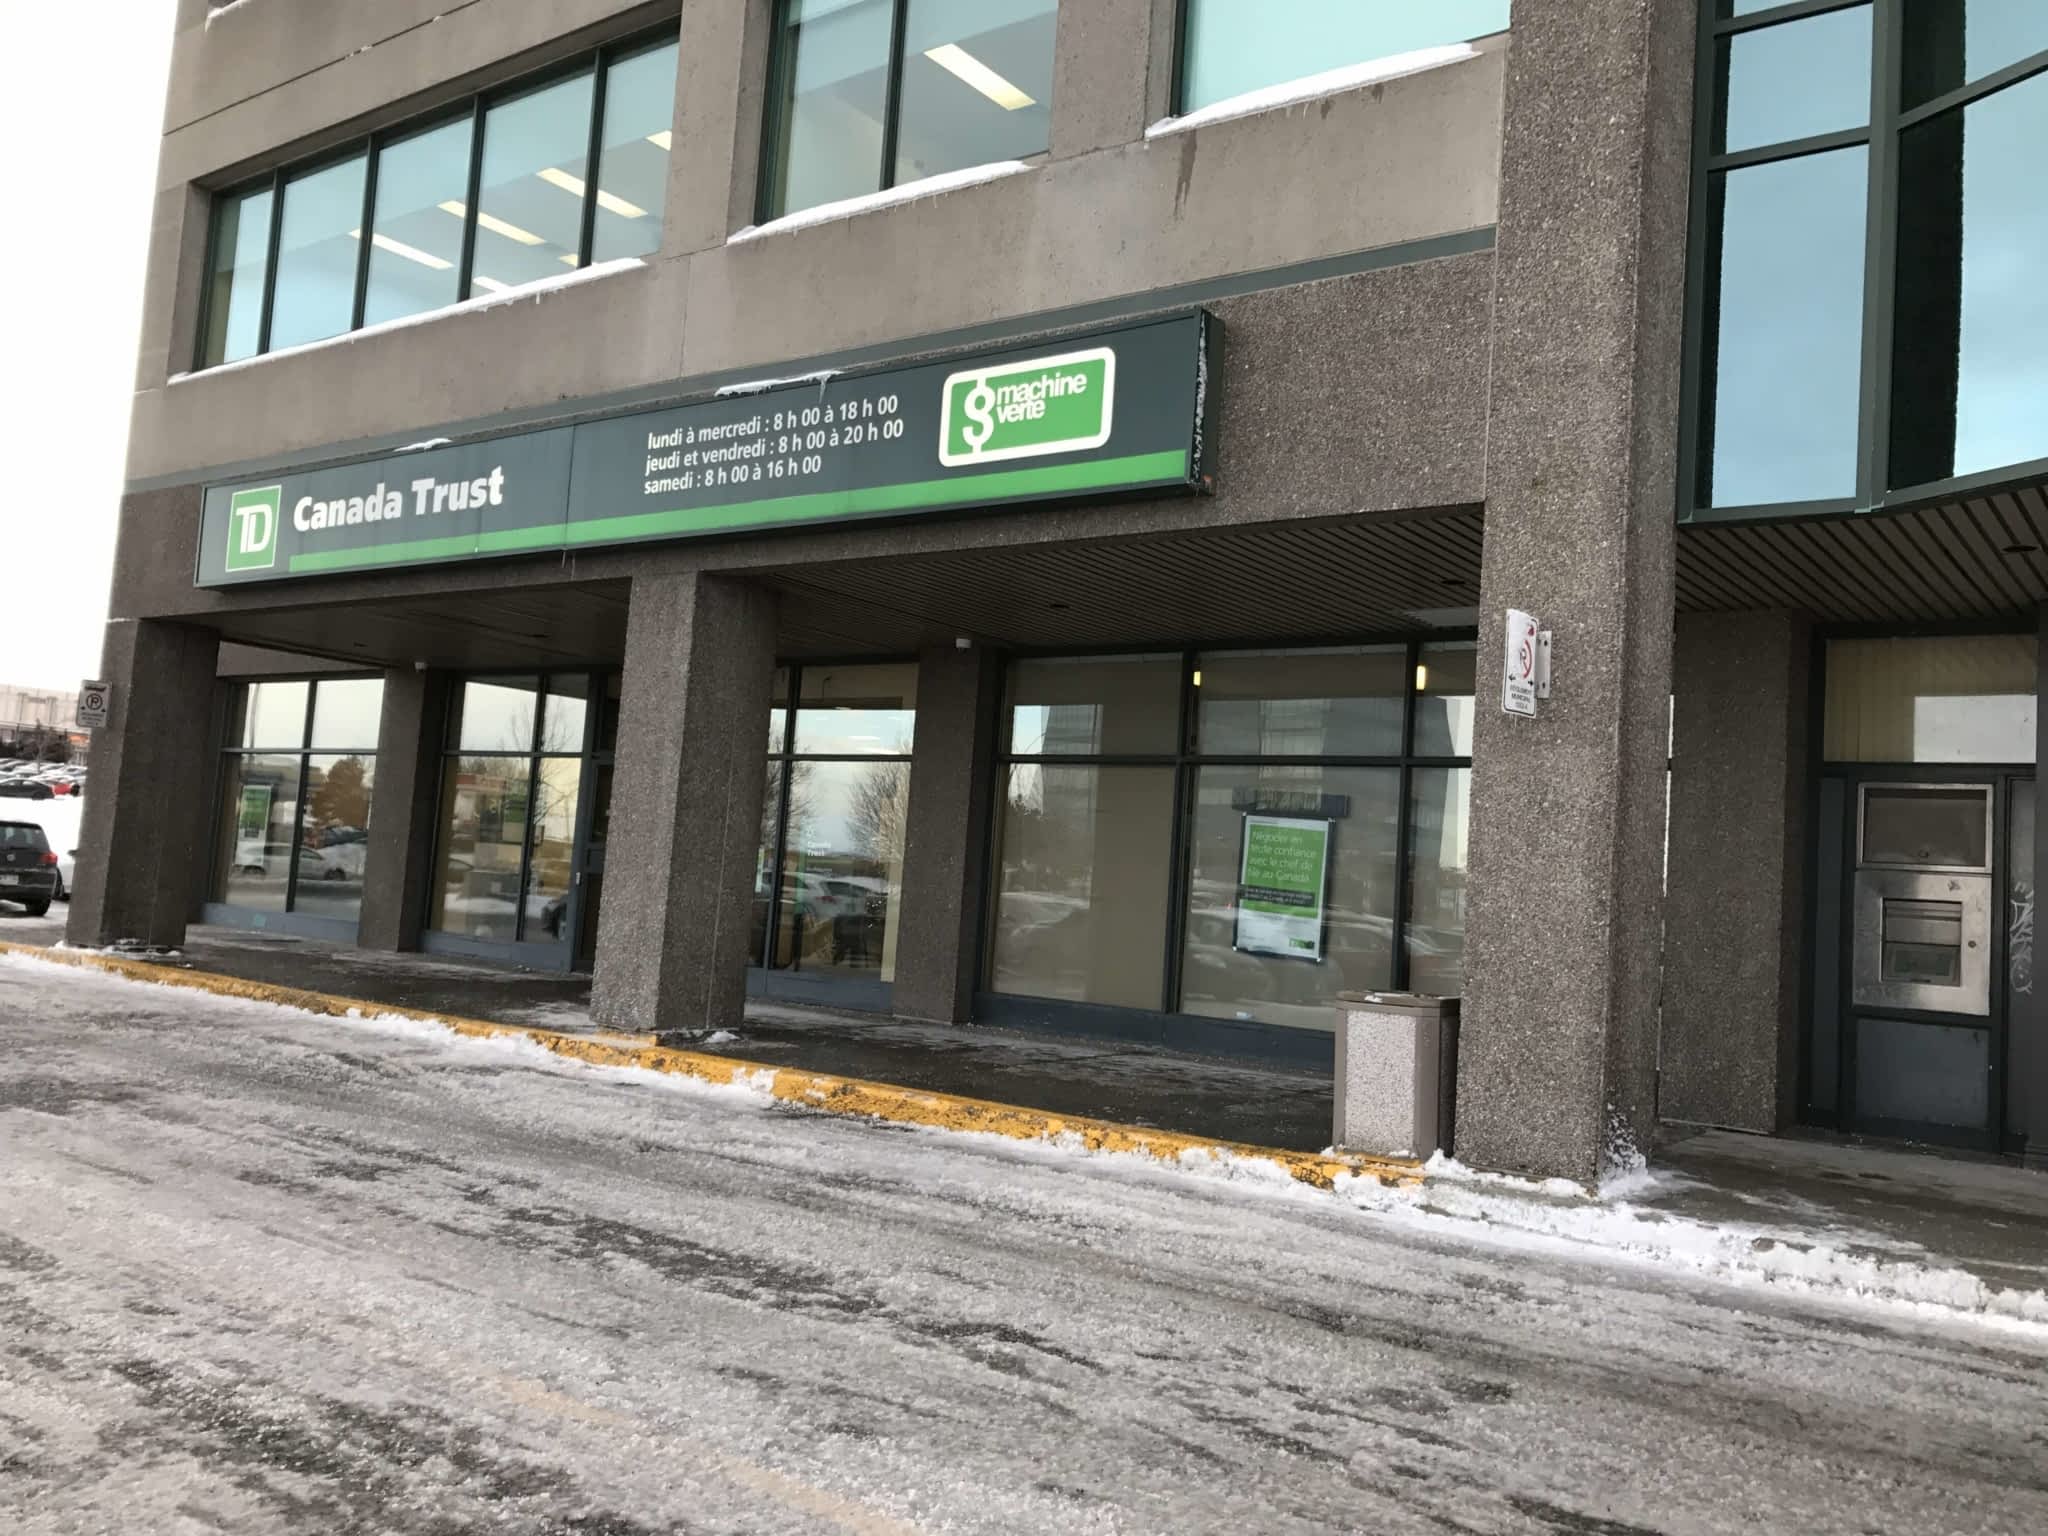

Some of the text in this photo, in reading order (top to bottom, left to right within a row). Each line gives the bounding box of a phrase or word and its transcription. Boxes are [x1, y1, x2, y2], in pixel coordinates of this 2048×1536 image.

[996, 372, 1087, 405] machine
[648, 431, 682, 449] lundi
[686, 428, 694, 444] à
[699, 416, 761, 442] mercredi
[774, 414, 783, 431] 8
[788, 411, 796, 428] h
[802, 407, 820, 426] 00
[825, 405, 834, 423] à
[840, 401, 857, 420] 18
[862, 399, 872, 417] h
[878, 395, 898, 414] 00
[996, 400, 1046, 424] verte
[645, 453, 680, 476] jeudi
[684, 450, 698, 466] et
[702, 438, 765, 465] vendredi
[778, 437, 787, 454] 8
[793, 434, 801, 452] h
[807, 431, 825, 449] 00
[830, 428, 839, 446] à
[844, 426, 862, 444] 20
[868, 423, 878, 441] h
[884, 419, 903, 438] 00
[644, 473, 693, 495] samedi
[705, 470, 713, 487] 8
[718, 467, 726, 485] h
[731, 464, 749, 483] 00
[752, 463, 761, 481] à
[767, 460, 783, 479] 16
[788, 457, 797, 475] h
[803, 455, 821, 474] 00
[236, 466, 504, 553] TD Canada Trust
[1273, 846, 1316, 859] confiance
[1275, 870, 1310, 882] Canada
